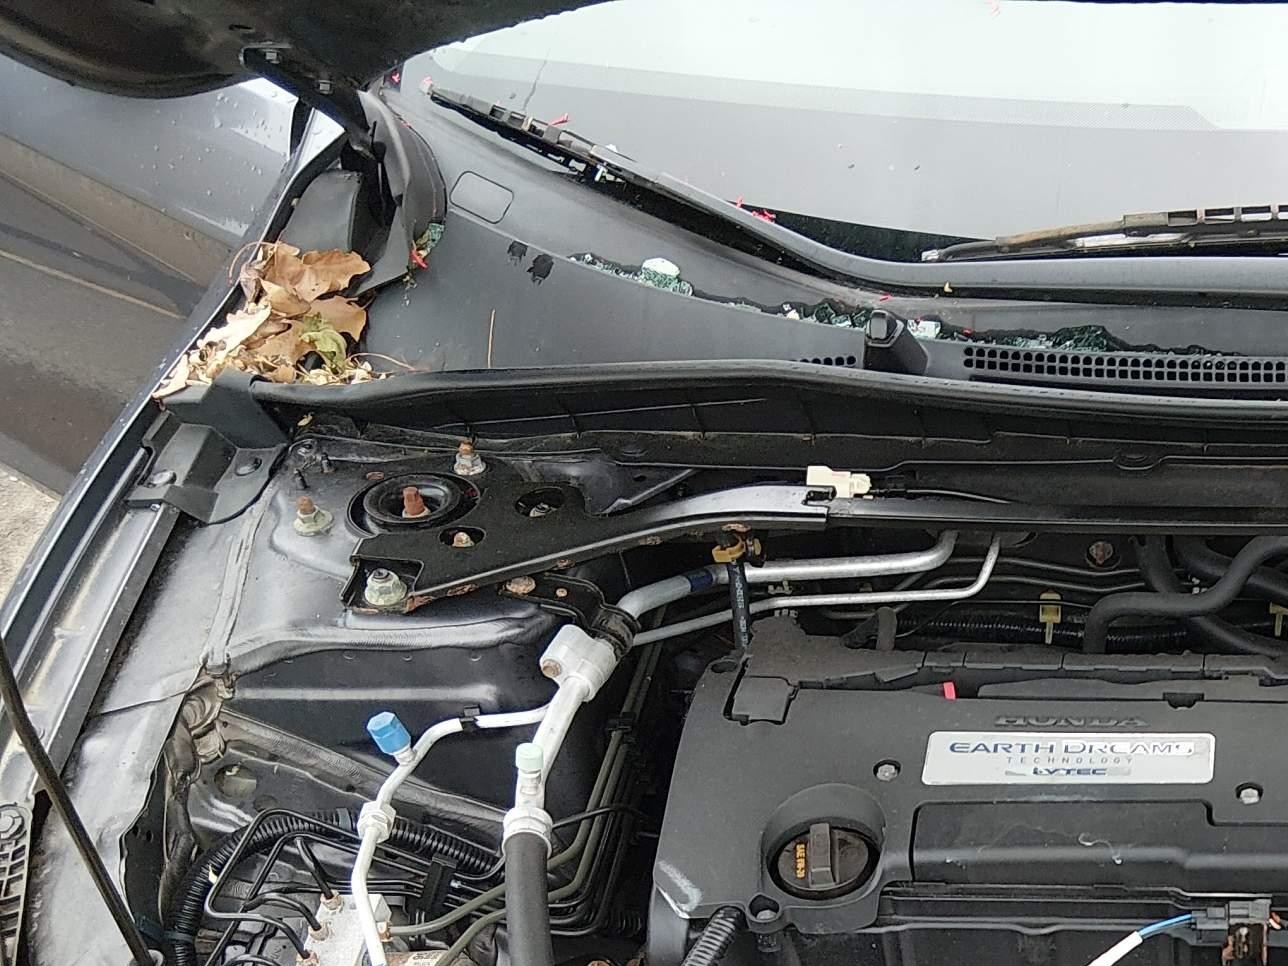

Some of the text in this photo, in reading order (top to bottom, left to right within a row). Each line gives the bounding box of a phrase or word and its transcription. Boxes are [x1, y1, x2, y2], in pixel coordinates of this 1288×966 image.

[994, 715, 1150, 728] HONDA
[949, 742, 1055, 754] EARTH
[1006, 756, 1134, 765] TECHNOLOGY
